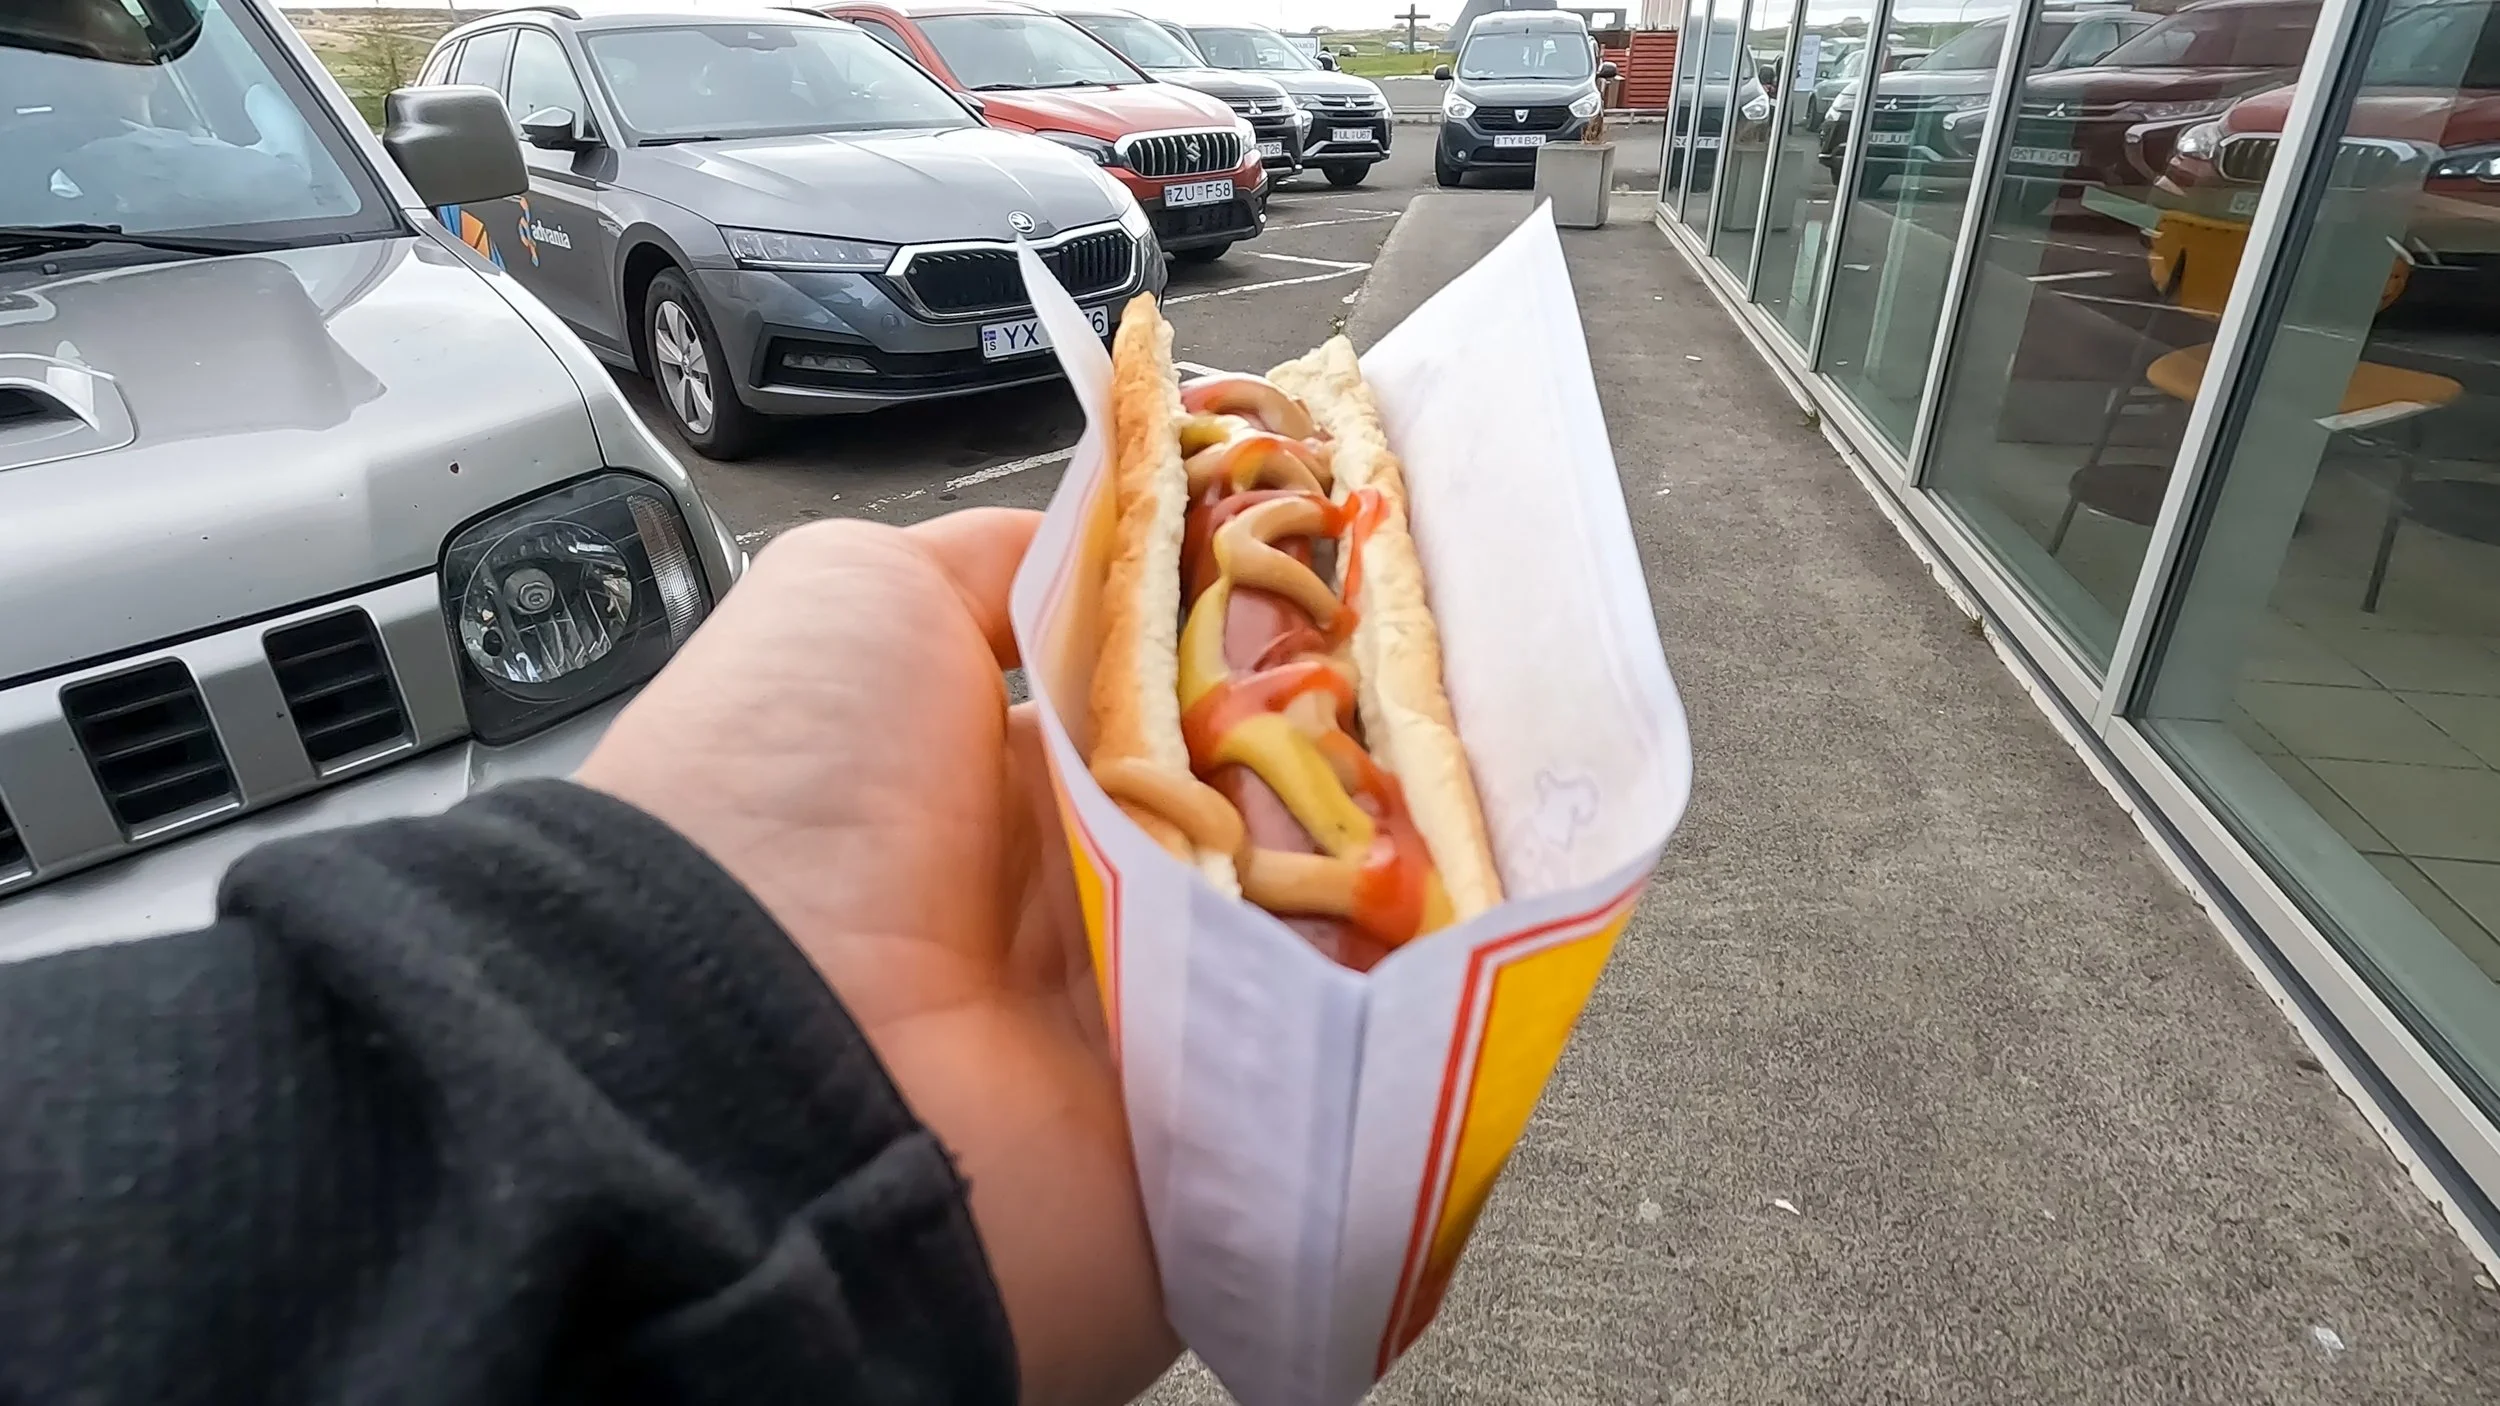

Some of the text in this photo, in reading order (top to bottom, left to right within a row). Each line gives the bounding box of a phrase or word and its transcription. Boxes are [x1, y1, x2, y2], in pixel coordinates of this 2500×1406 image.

[1502, 136, 1516, 145] TY
[1263, 143, 1281, 155] T26
[1174, 185, 1195, 203] ZU
[1205, 182, 1231, 199] F58
[530, 219, 572, 250] advania
[1003, 322, 1040, 350] YX
[984, 341, 997, 352] IS
